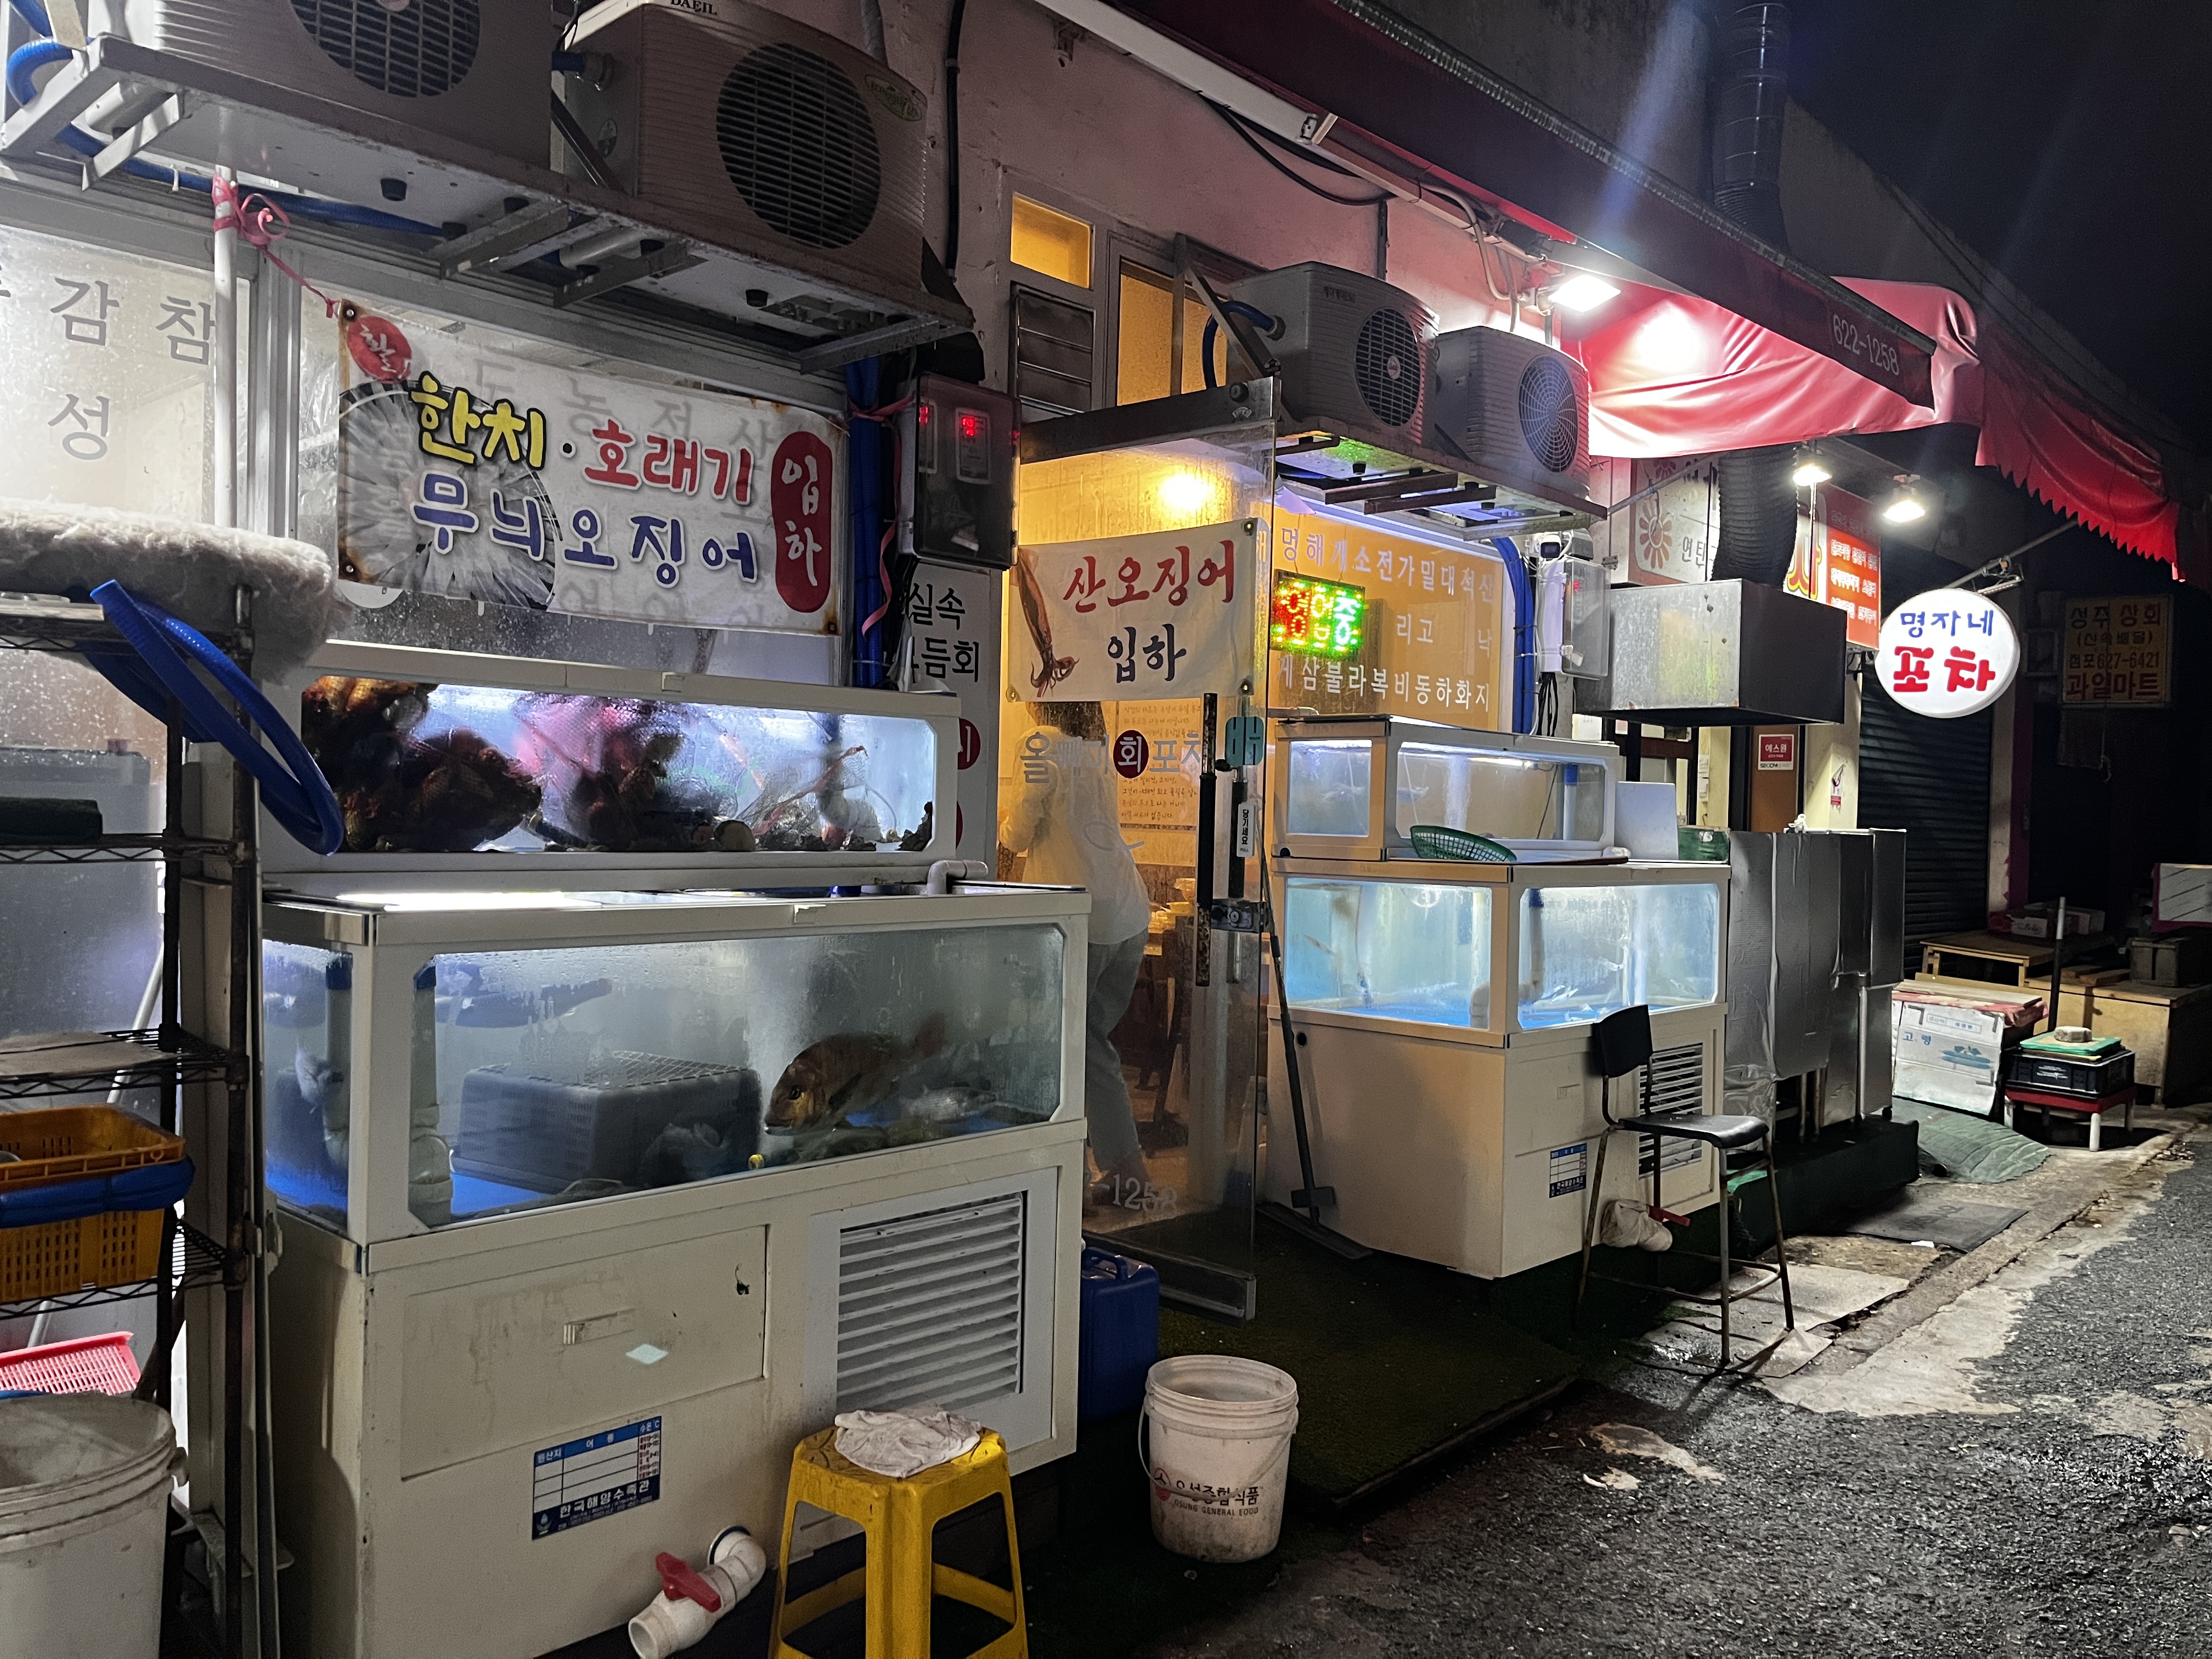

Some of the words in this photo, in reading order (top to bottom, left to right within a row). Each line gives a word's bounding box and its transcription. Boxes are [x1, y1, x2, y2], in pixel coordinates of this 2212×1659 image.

[1832, 313, 1900, 376] 622-1258
[407, 370, 546, 470] 한치
[583, 418, 755, 506] 호래기
[782, 454, 823, 588] 입하
[1682, 537, 1716, 567] 연탄
[1063, 539, 1237, 613] 산오징어
[908, 583, 966, 630] 실속
[1280, 589, 1359, 646] 영업중
[1395, 555, 1415, 703] 가리비
[1900, 610, 1994, 638] 명자네
[911, 636, 979, 683] 듬회
[1107, 623, 1187, 684] 입하
[1893, 645, 1996, 692] 포차
[2066, 672, 2160, 701] 과일마트
[1118, 735, 1143, 773] 회
[1242, 809, 1250, 845] 당기세요
[1174, 1498, 1198, 1513] OSUNG
[1201, 1506, 1236, 1516] GENERAL
